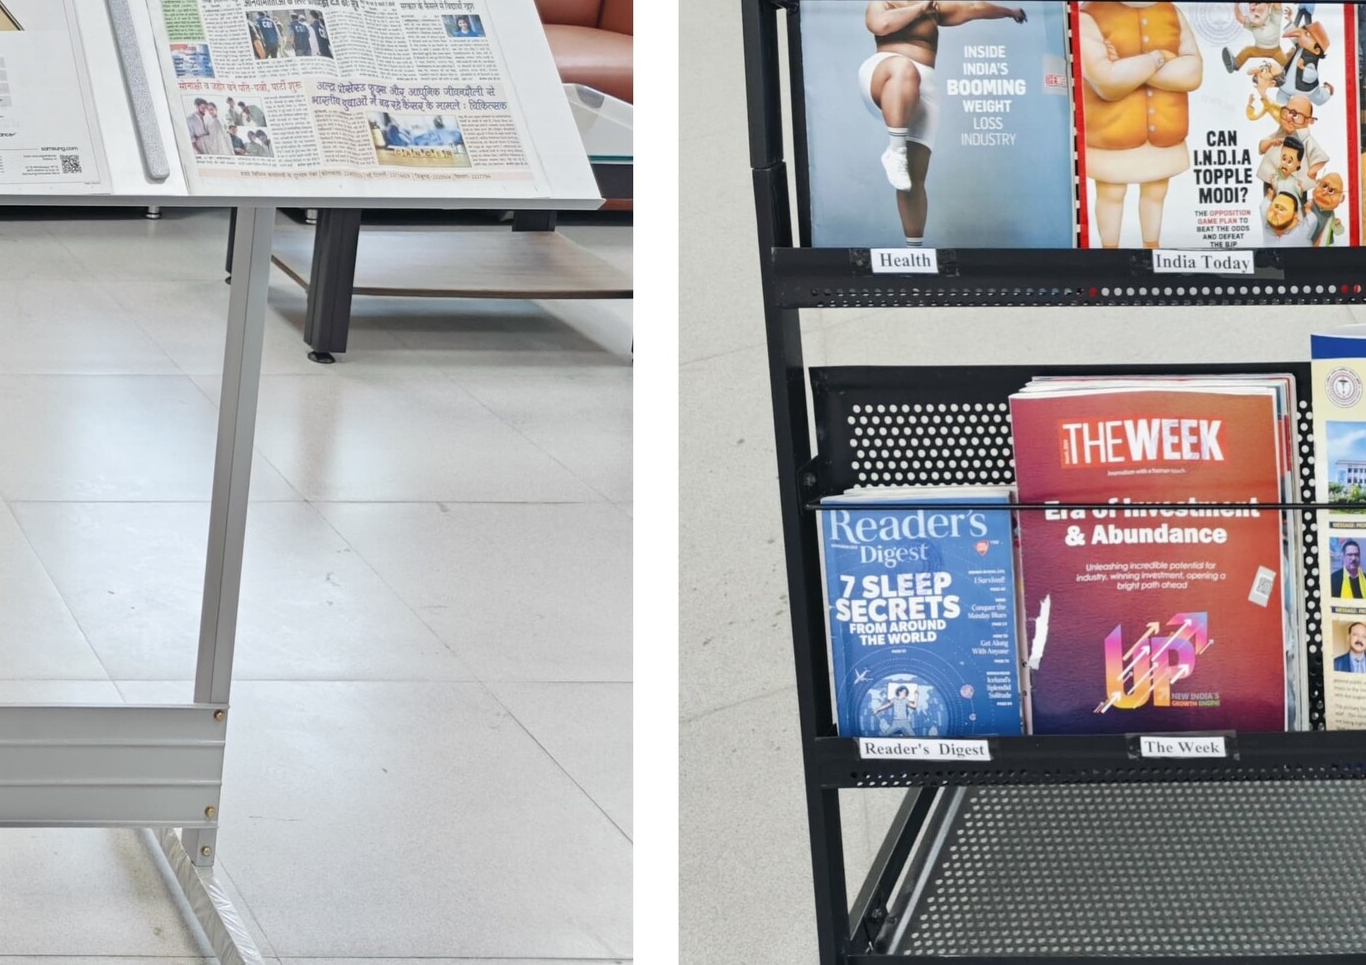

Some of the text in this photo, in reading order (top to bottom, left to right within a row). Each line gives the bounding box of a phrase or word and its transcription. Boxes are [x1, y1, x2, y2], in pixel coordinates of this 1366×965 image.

[947, 79, 1026, 96] BOOMING
[963, 99, 1012, 113] WEIGHT
[961, 132, 1016, 146] INDUSTRY
[1193, 168, 1253, 186] TOPPLE
[1198, 185, 1248, 205] MODI?
[880, 253, 931, 268] Health
[1155, 255, 1251, 274] India Today
[830, 509, 987, 543] Reader's
[1091, 523, 1228, 546] Abundance
[860, 544, 929, 568] Digest
[1086, 561, 1168, 572] Unleashing incredible
[840, 571, 952, 599] 7 SLEEP
[835, 595, 961, 623] SECRETS
[865, 741, 985, 758] Reader's Digest
[1144, 740, 1219, 755] The Week
